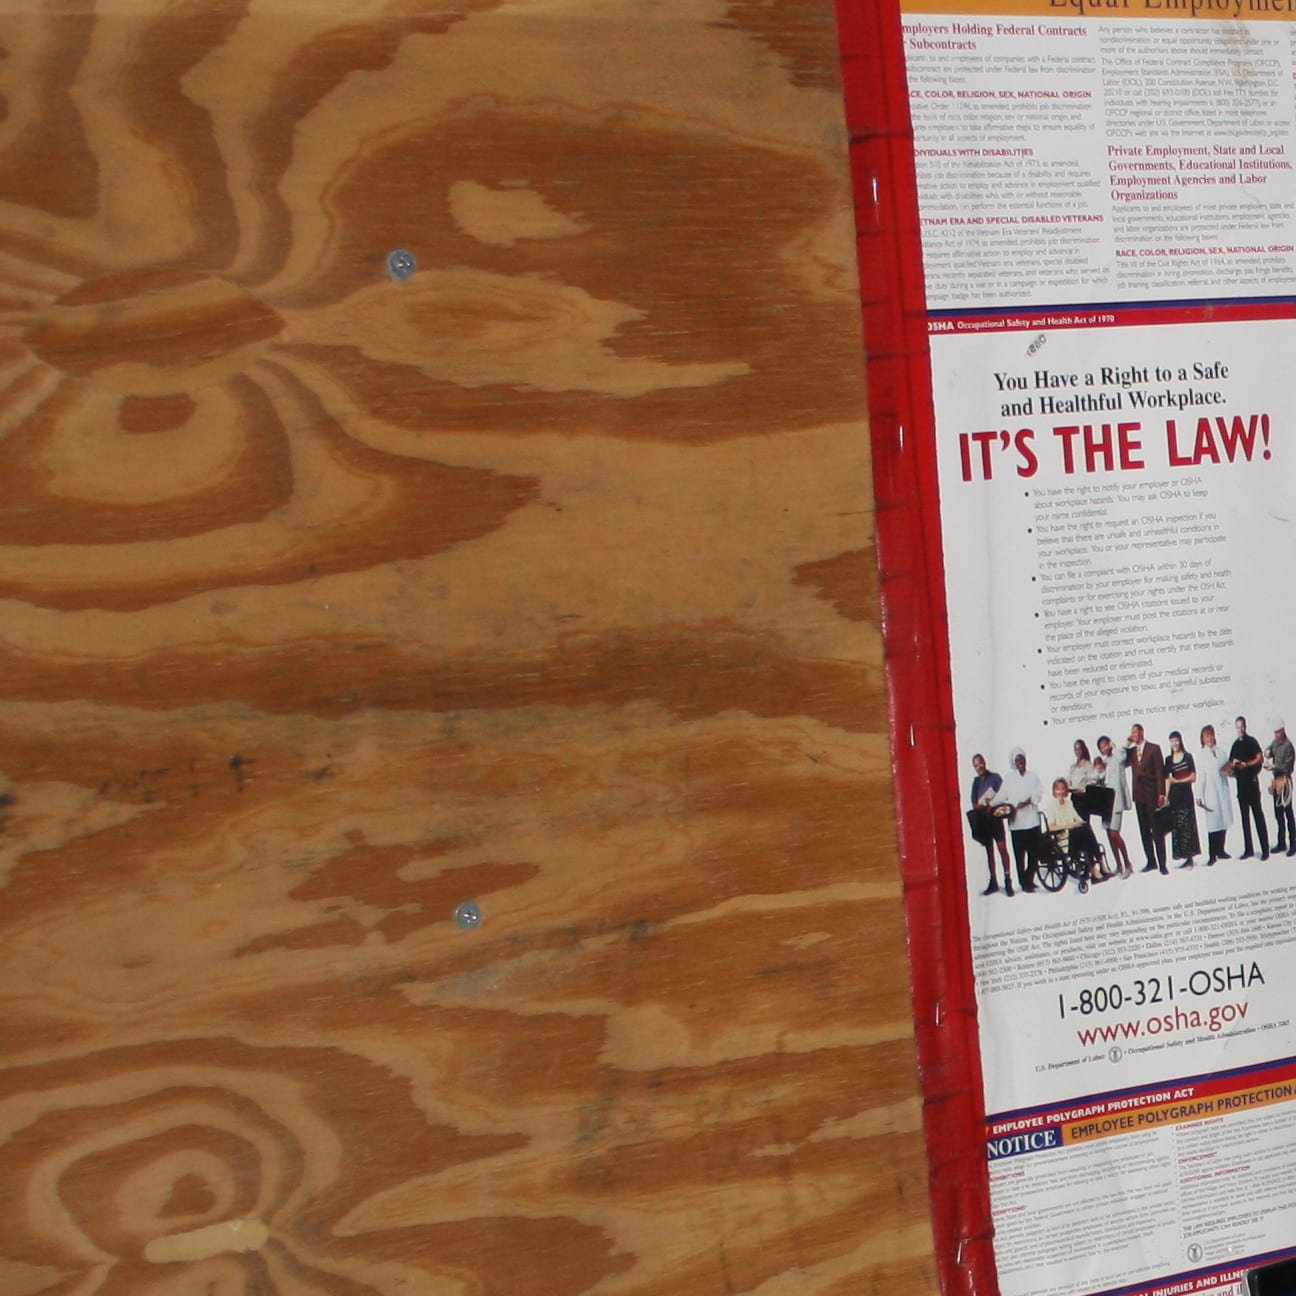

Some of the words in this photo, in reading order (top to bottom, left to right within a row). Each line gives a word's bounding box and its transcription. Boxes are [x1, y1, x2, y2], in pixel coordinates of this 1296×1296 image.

[902, 24, 948, 37] mployers
[952, 23, 992, 37] Holding
[996, 24, 1034, 35] Federal
[1038, 25, 1086, 36] Contracts
[909, 40, 976, 49] Subcontracts
[1108, 145, 1142, 156] Private
[1146, 146, 1210, 158] Employment,
[1213, 145, 1237, 155] State
[1239, 145, 1256, 154] and
[1259, 144, 1285, 155] Local
[994, 371, 1027, 392] You
[1034, 371, 1078, 390] Have
[1084, 374, 1094, 386] a
[1101, 365, 1149, 389] Right
[1155, 366, 1171, 383] to
[1178, 368, 1187, 381] a
[1193, 361, 1229, 380] Safe
[1001, 396, 1033, 417] and
[1040, 391, 1122, 415] Healthful
[1129, 388, 1226, 412] Workplace.
[959, 428, 1038, 482] IT'S
[1053, 422, 1145, 474] THE
[1166, 413, 1272, 467] LAW!
[1059, 961, 1265, 1019] 1-800-321-OSHA
[1077, 1001, 1248, 1047] www.osha.gov
[1072, 1118, 1134, 1139] EMPLOYEE
[1138, 1102, 1213, 1125] POLYGRAPH
[1217, 1088, 1292, 1112] PROTECTION
[987, 1129, 1056, 1159] NOTICE
[1197, 1278, 1218, 1289] AND
